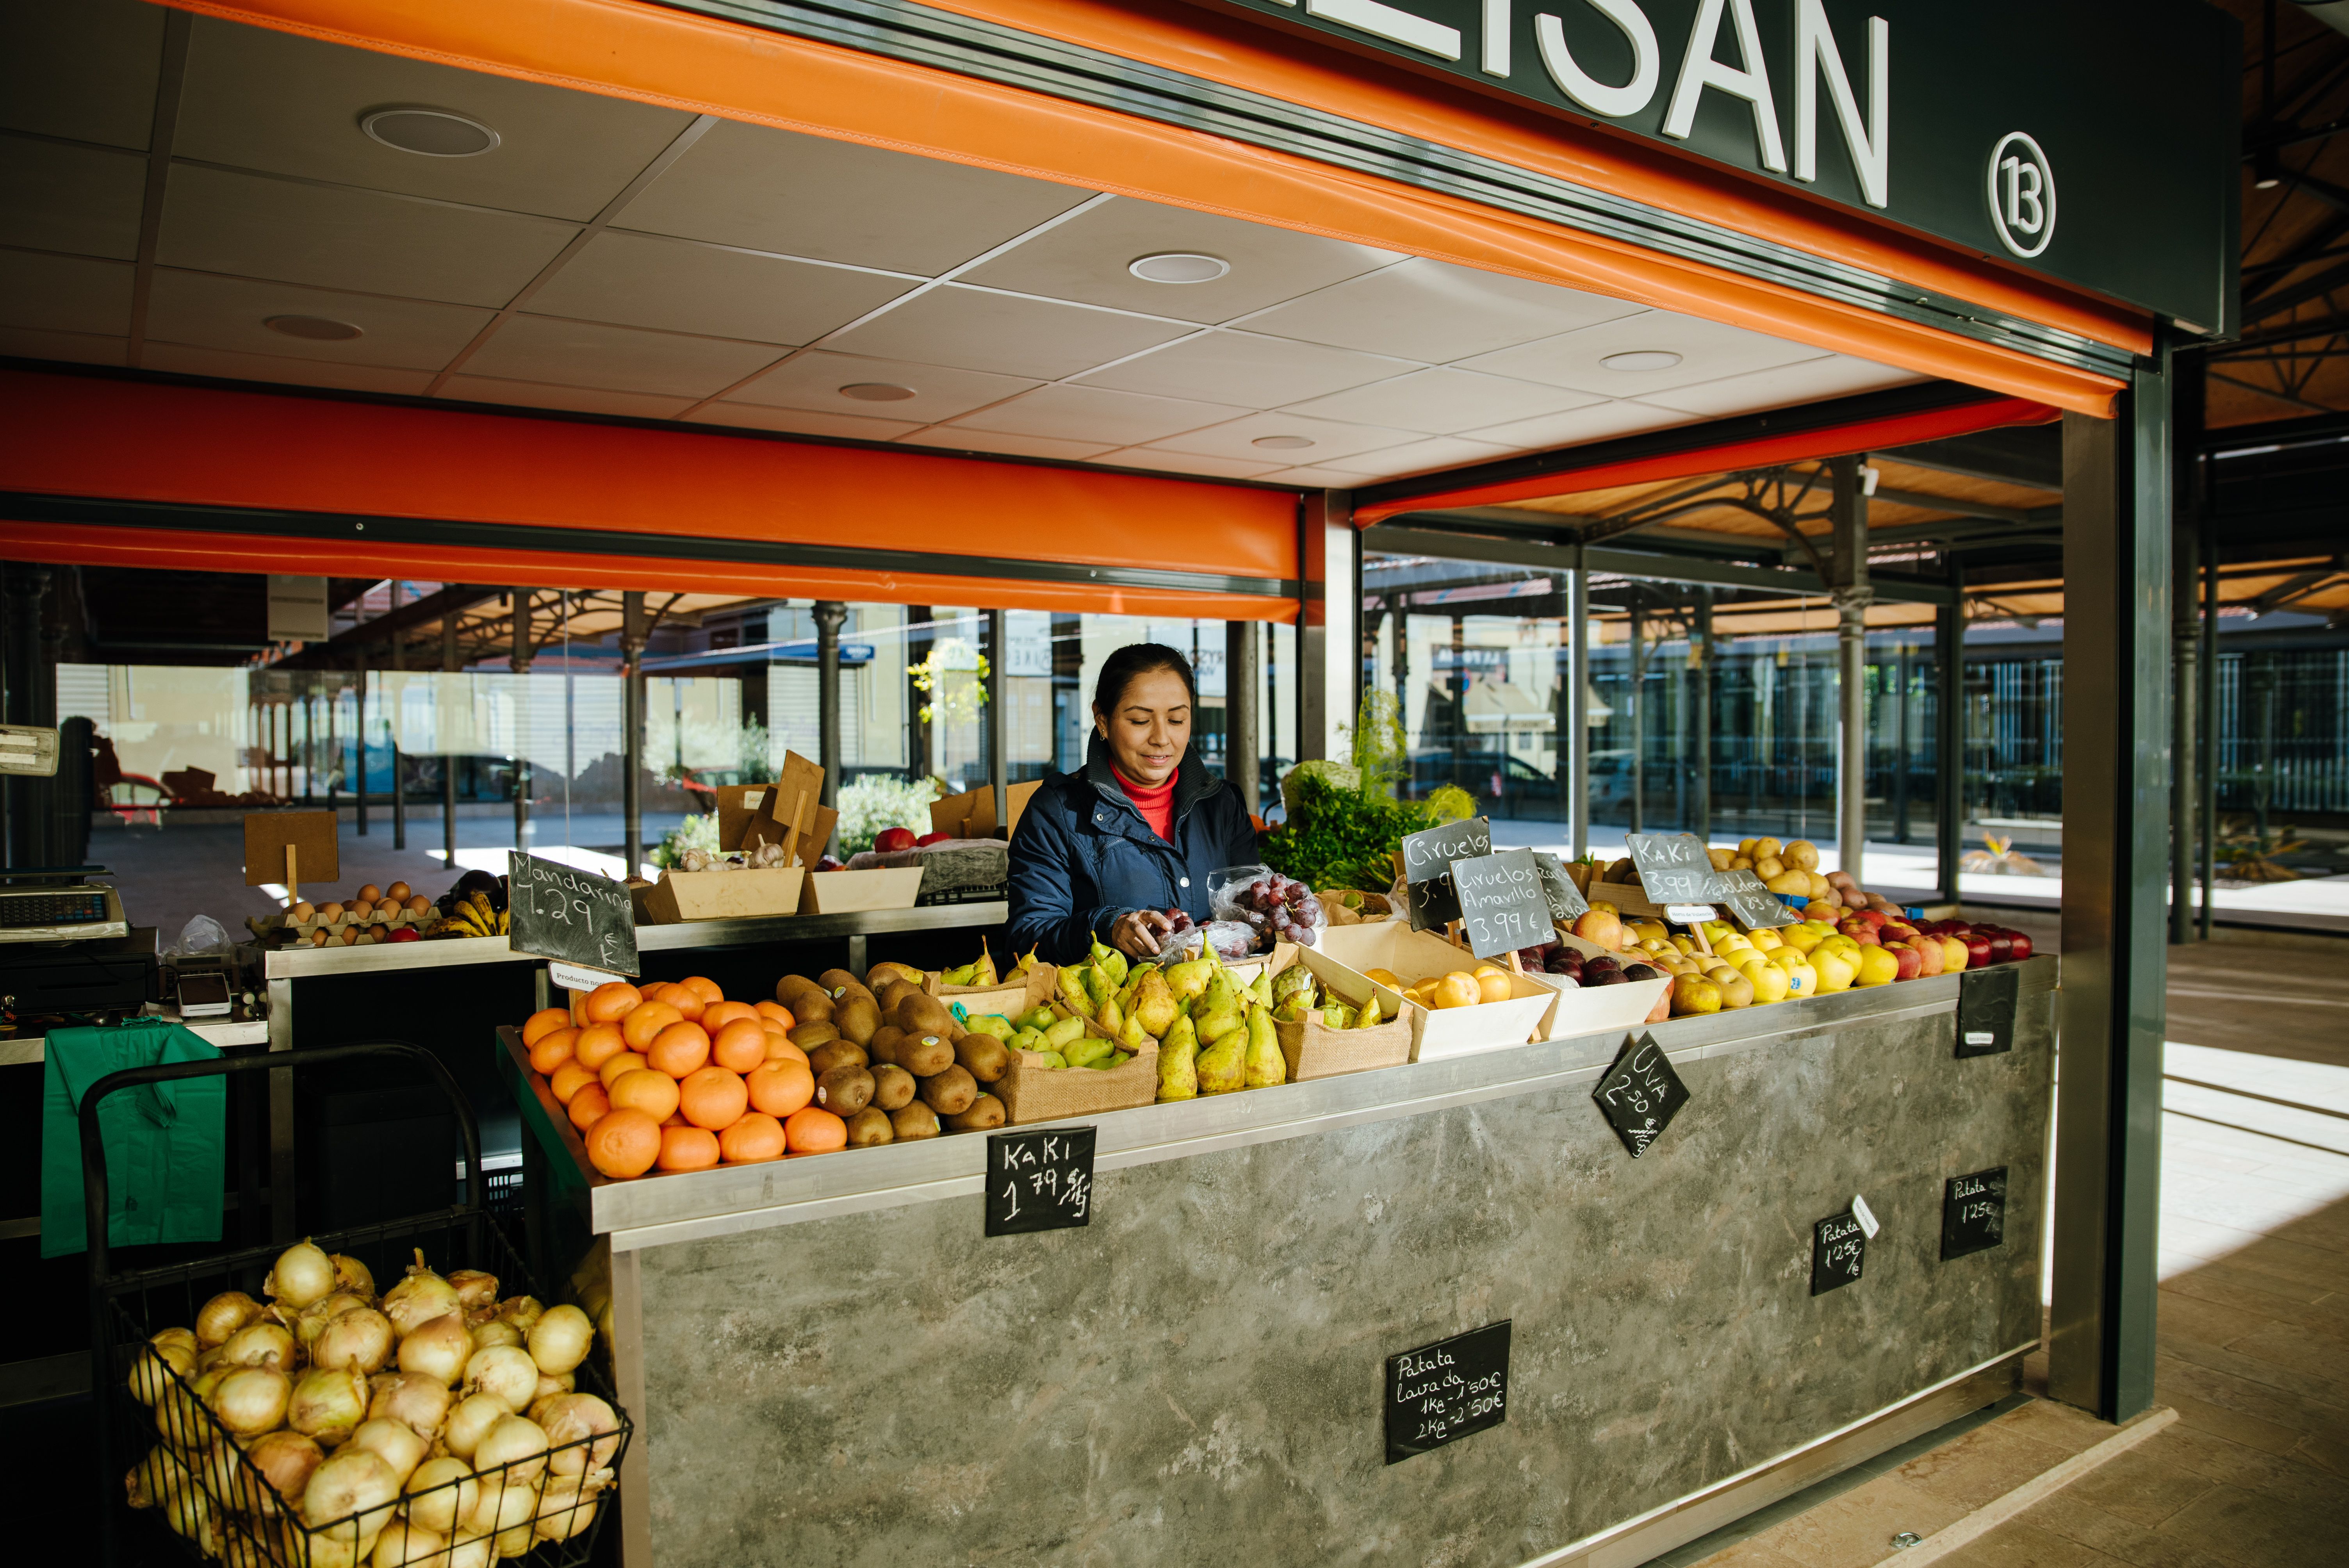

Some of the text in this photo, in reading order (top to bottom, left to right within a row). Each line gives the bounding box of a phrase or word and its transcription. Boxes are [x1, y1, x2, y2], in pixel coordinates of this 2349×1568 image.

[2000, 156, 2043, 234] 13
[514, 853, 633, 910] Mandarina
[1417, 871, 1453, 908] 3.9
[1455, 862, 1534, 889] Ciruelos
[1645, 871, 1693, 898] 3.99
[1463, 886, 1536, 908] Amarillo
[1473, 912, 1522, 943] 3.99
[557, 973, 588, 984] Producto
[1634, 1044, 1665, 1103] UVA
[1953, 1178, 1986, 1200] Patata
[1820, 1218, 1861, 1244] Patata
[1397, 1349, 1455, 1381] Patata
